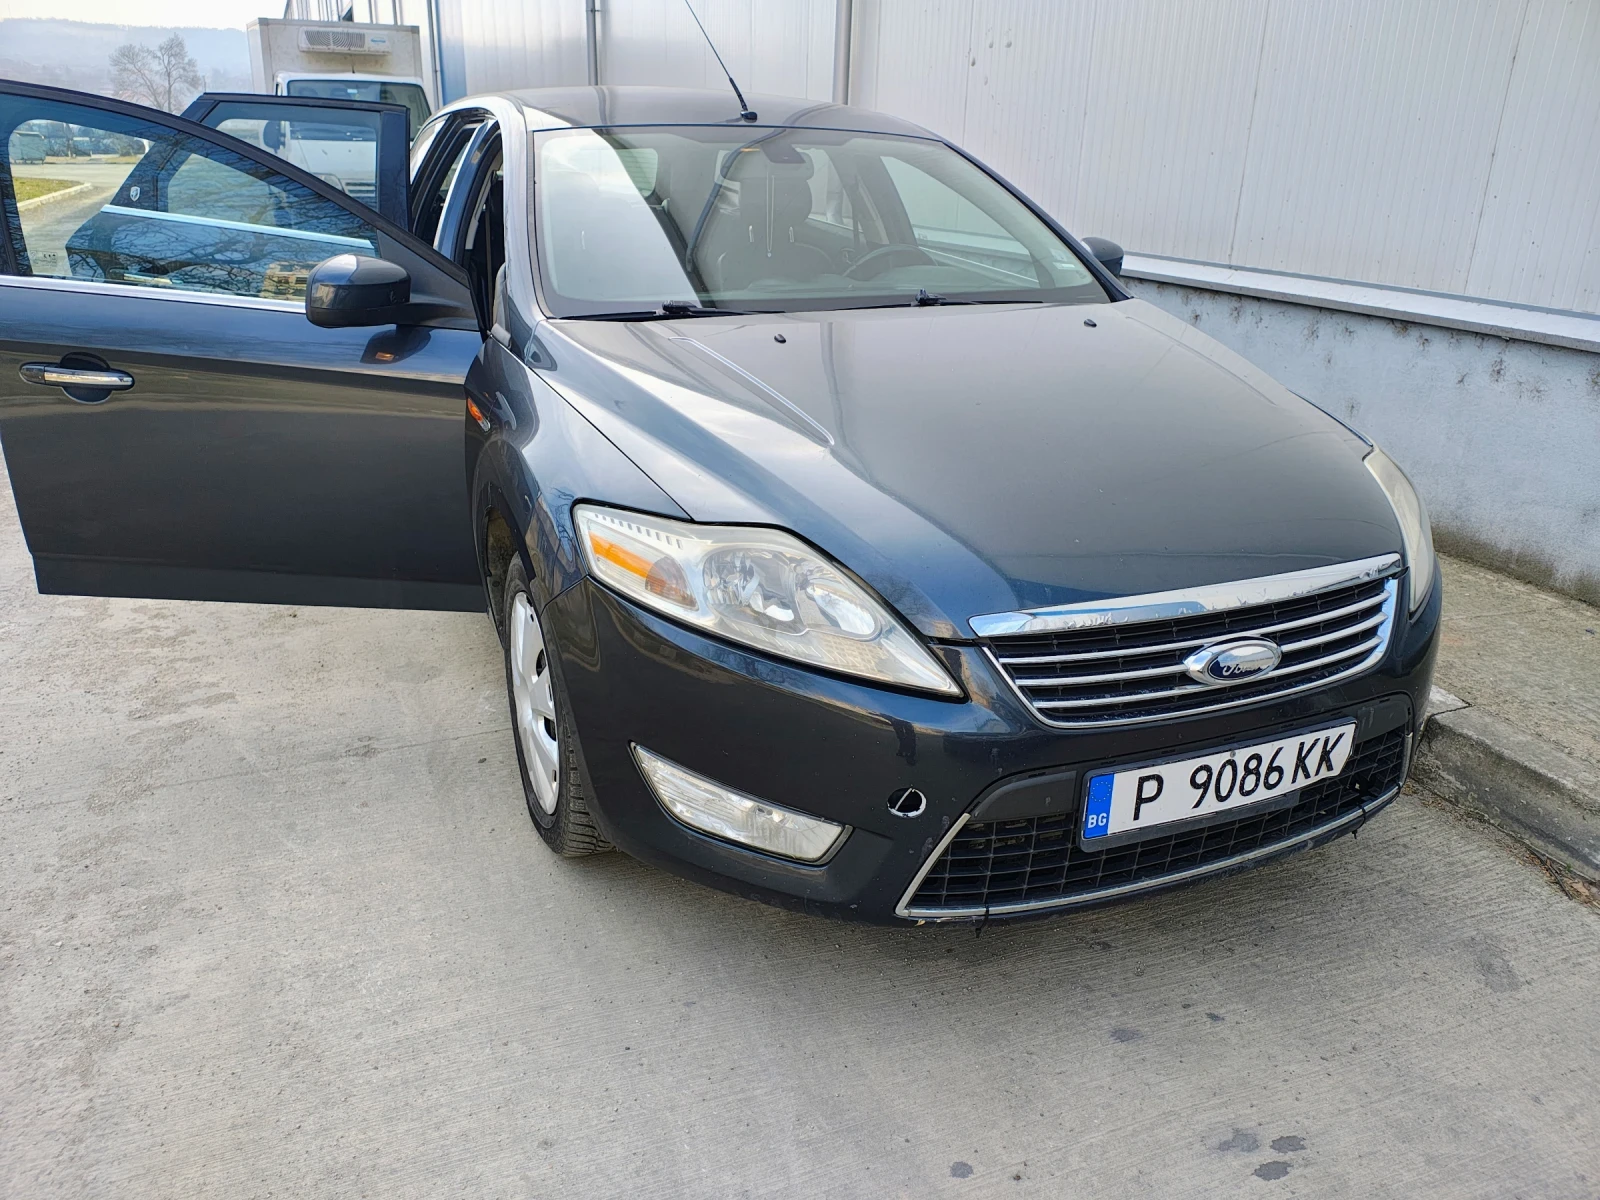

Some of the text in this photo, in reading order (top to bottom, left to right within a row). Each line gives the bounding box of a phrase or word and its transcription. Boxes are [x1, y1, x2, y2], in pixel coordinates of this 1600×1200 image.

[1132, 732, 1346, 821] P 9086 KK
[1087, 812, 1107, 829] BG
